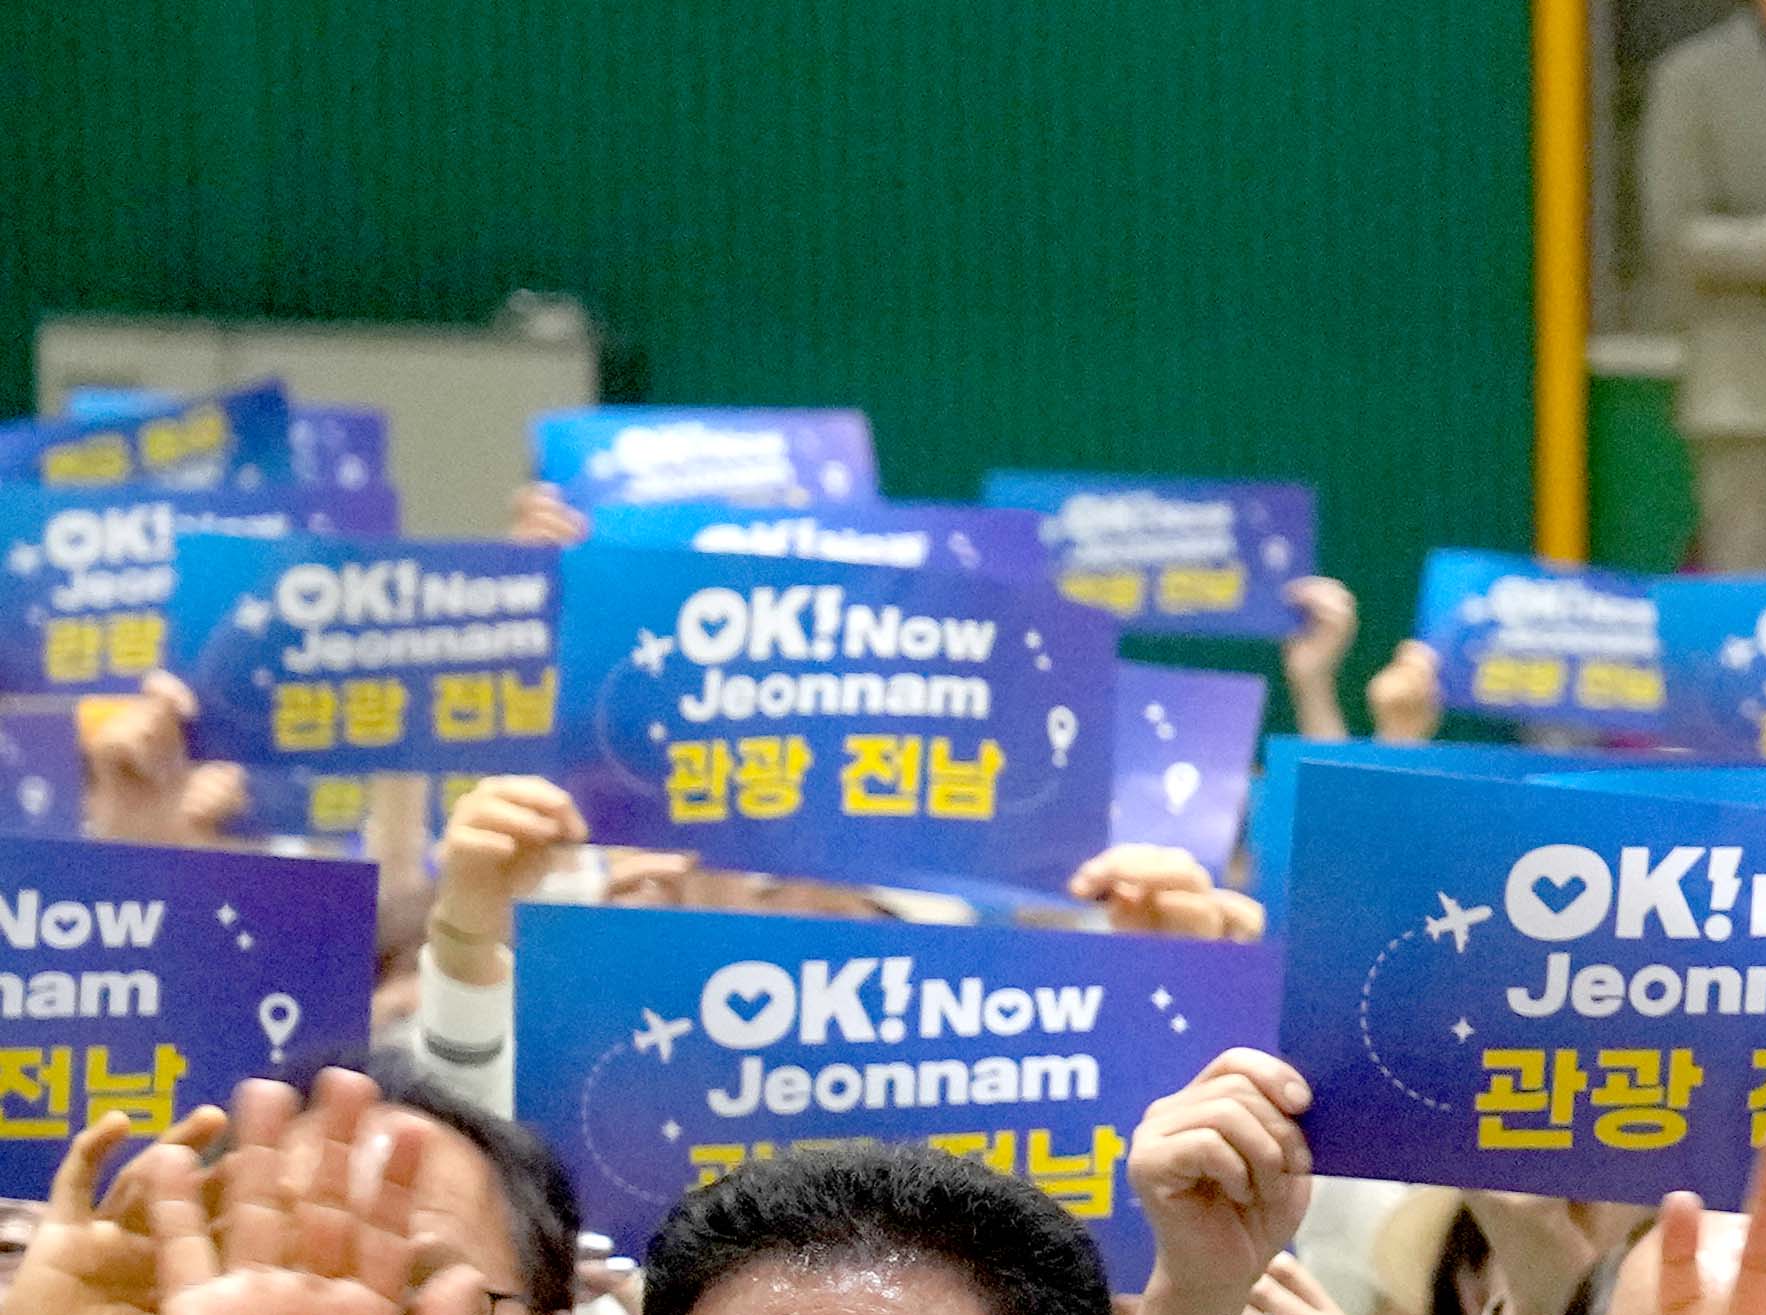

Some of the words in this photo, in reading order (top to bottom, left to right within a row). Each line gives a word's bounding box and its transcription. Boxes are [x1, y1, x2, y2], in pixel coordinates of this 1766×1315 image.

[277, 565, 419, 626] OK!
[677, 587, 844, 665] OK!
[845, 605, 995, 662] Now
[678, 673, 991, 723] Jeonnam
[666, 734, 812, 823] 관광
[841, 734, 1005, 820] 전남
[1503, 844, 1743, 942] OK!
[700, 957, 915, 1050] OK!
[920, 978, 1103, 1039] Now
[707, 1053, 1099, 1119] Jeonnam
[1473, 1047, 1705, 1151] 관광
